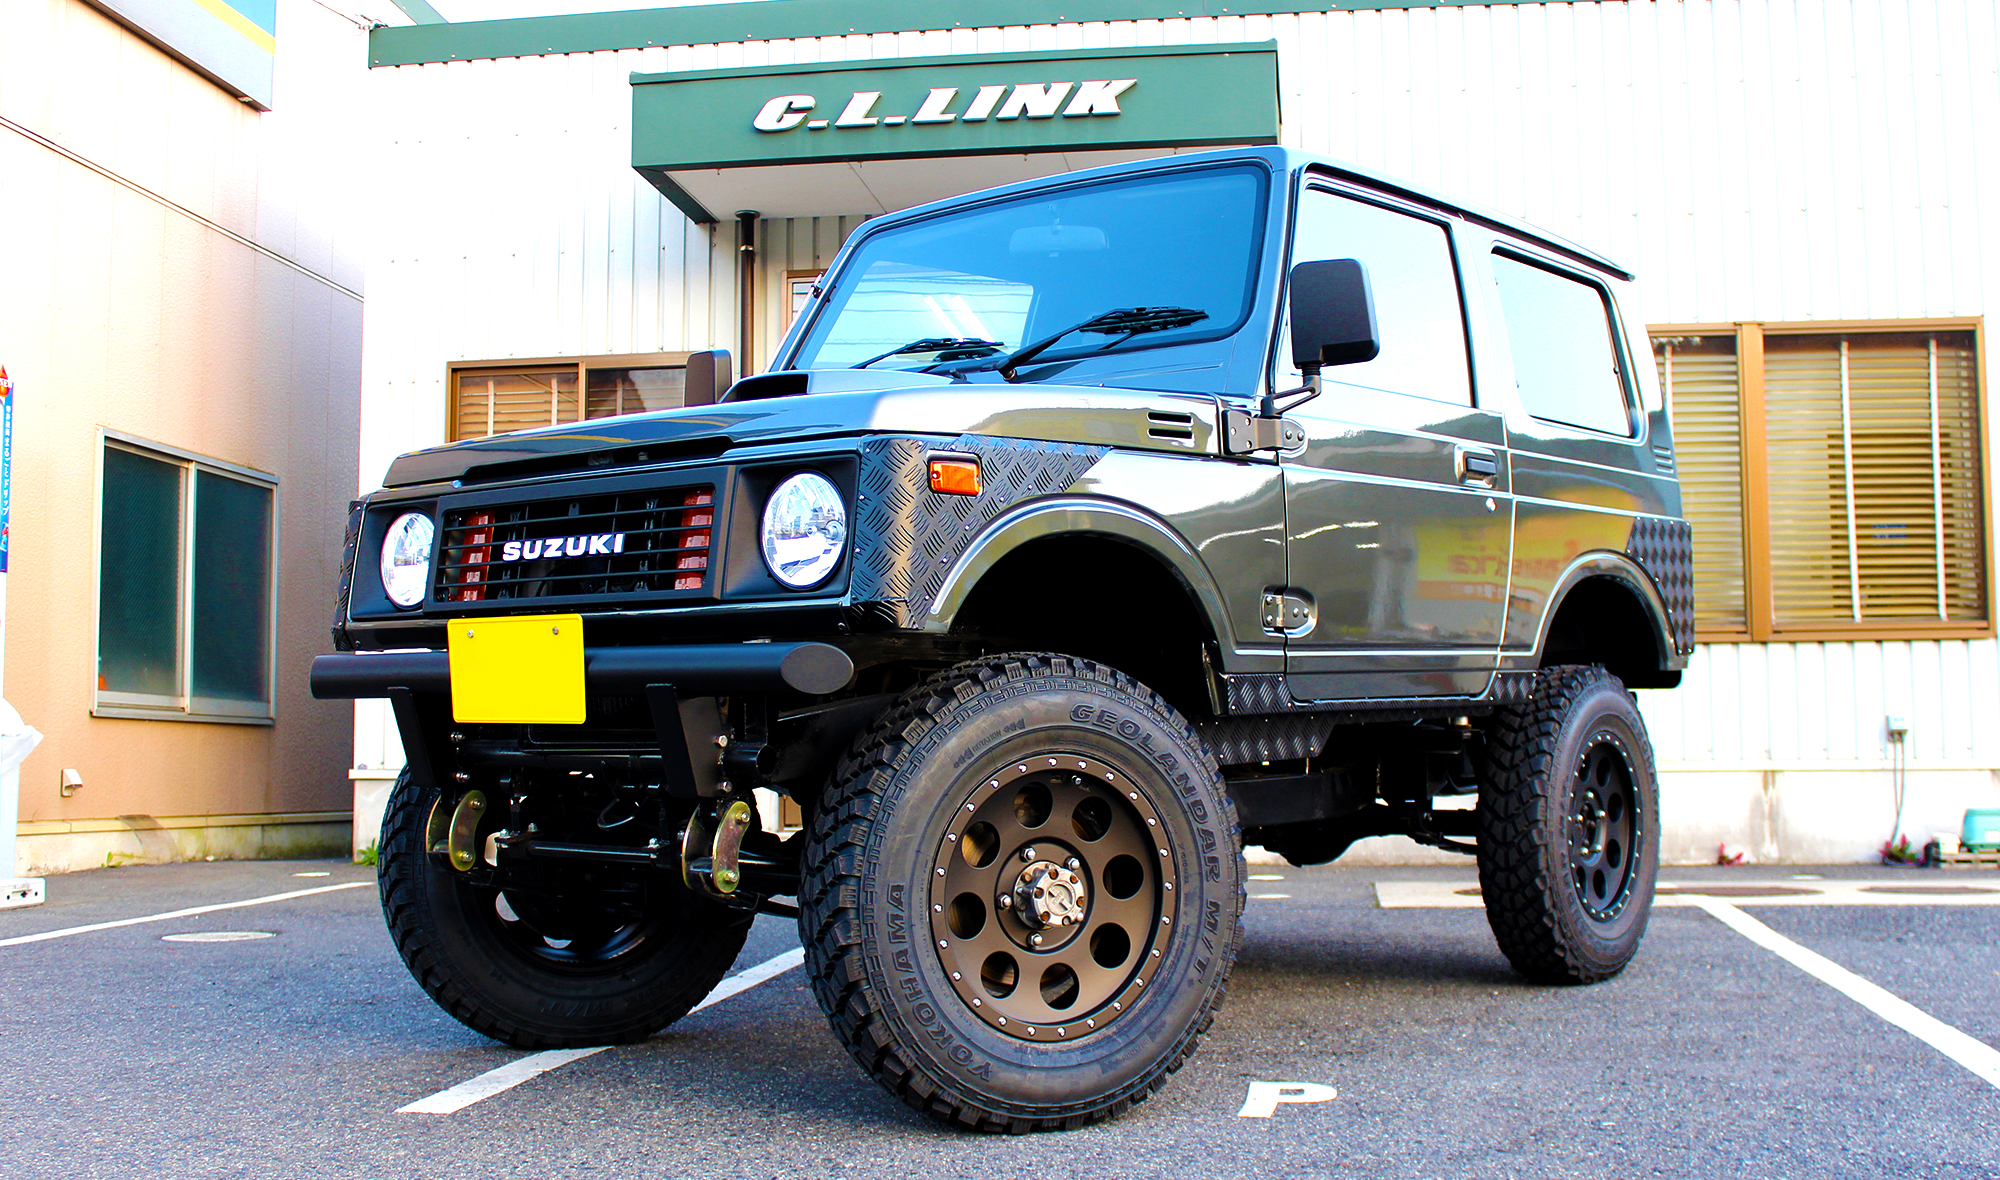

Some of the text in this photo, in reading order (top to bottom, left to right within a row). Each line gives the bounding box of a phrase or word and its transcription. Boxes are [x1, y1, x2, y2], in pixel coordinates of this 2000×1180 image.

[752, 78, 1139, 132] C.L.LINK
[502, 533, 625, 562] SUZUKI
[1070, 703, 1220, 884] GEOLANDAR
[887, 882, 993, 1082] YOKOHAMA
[1237, 1081, 1338, 1118] P
